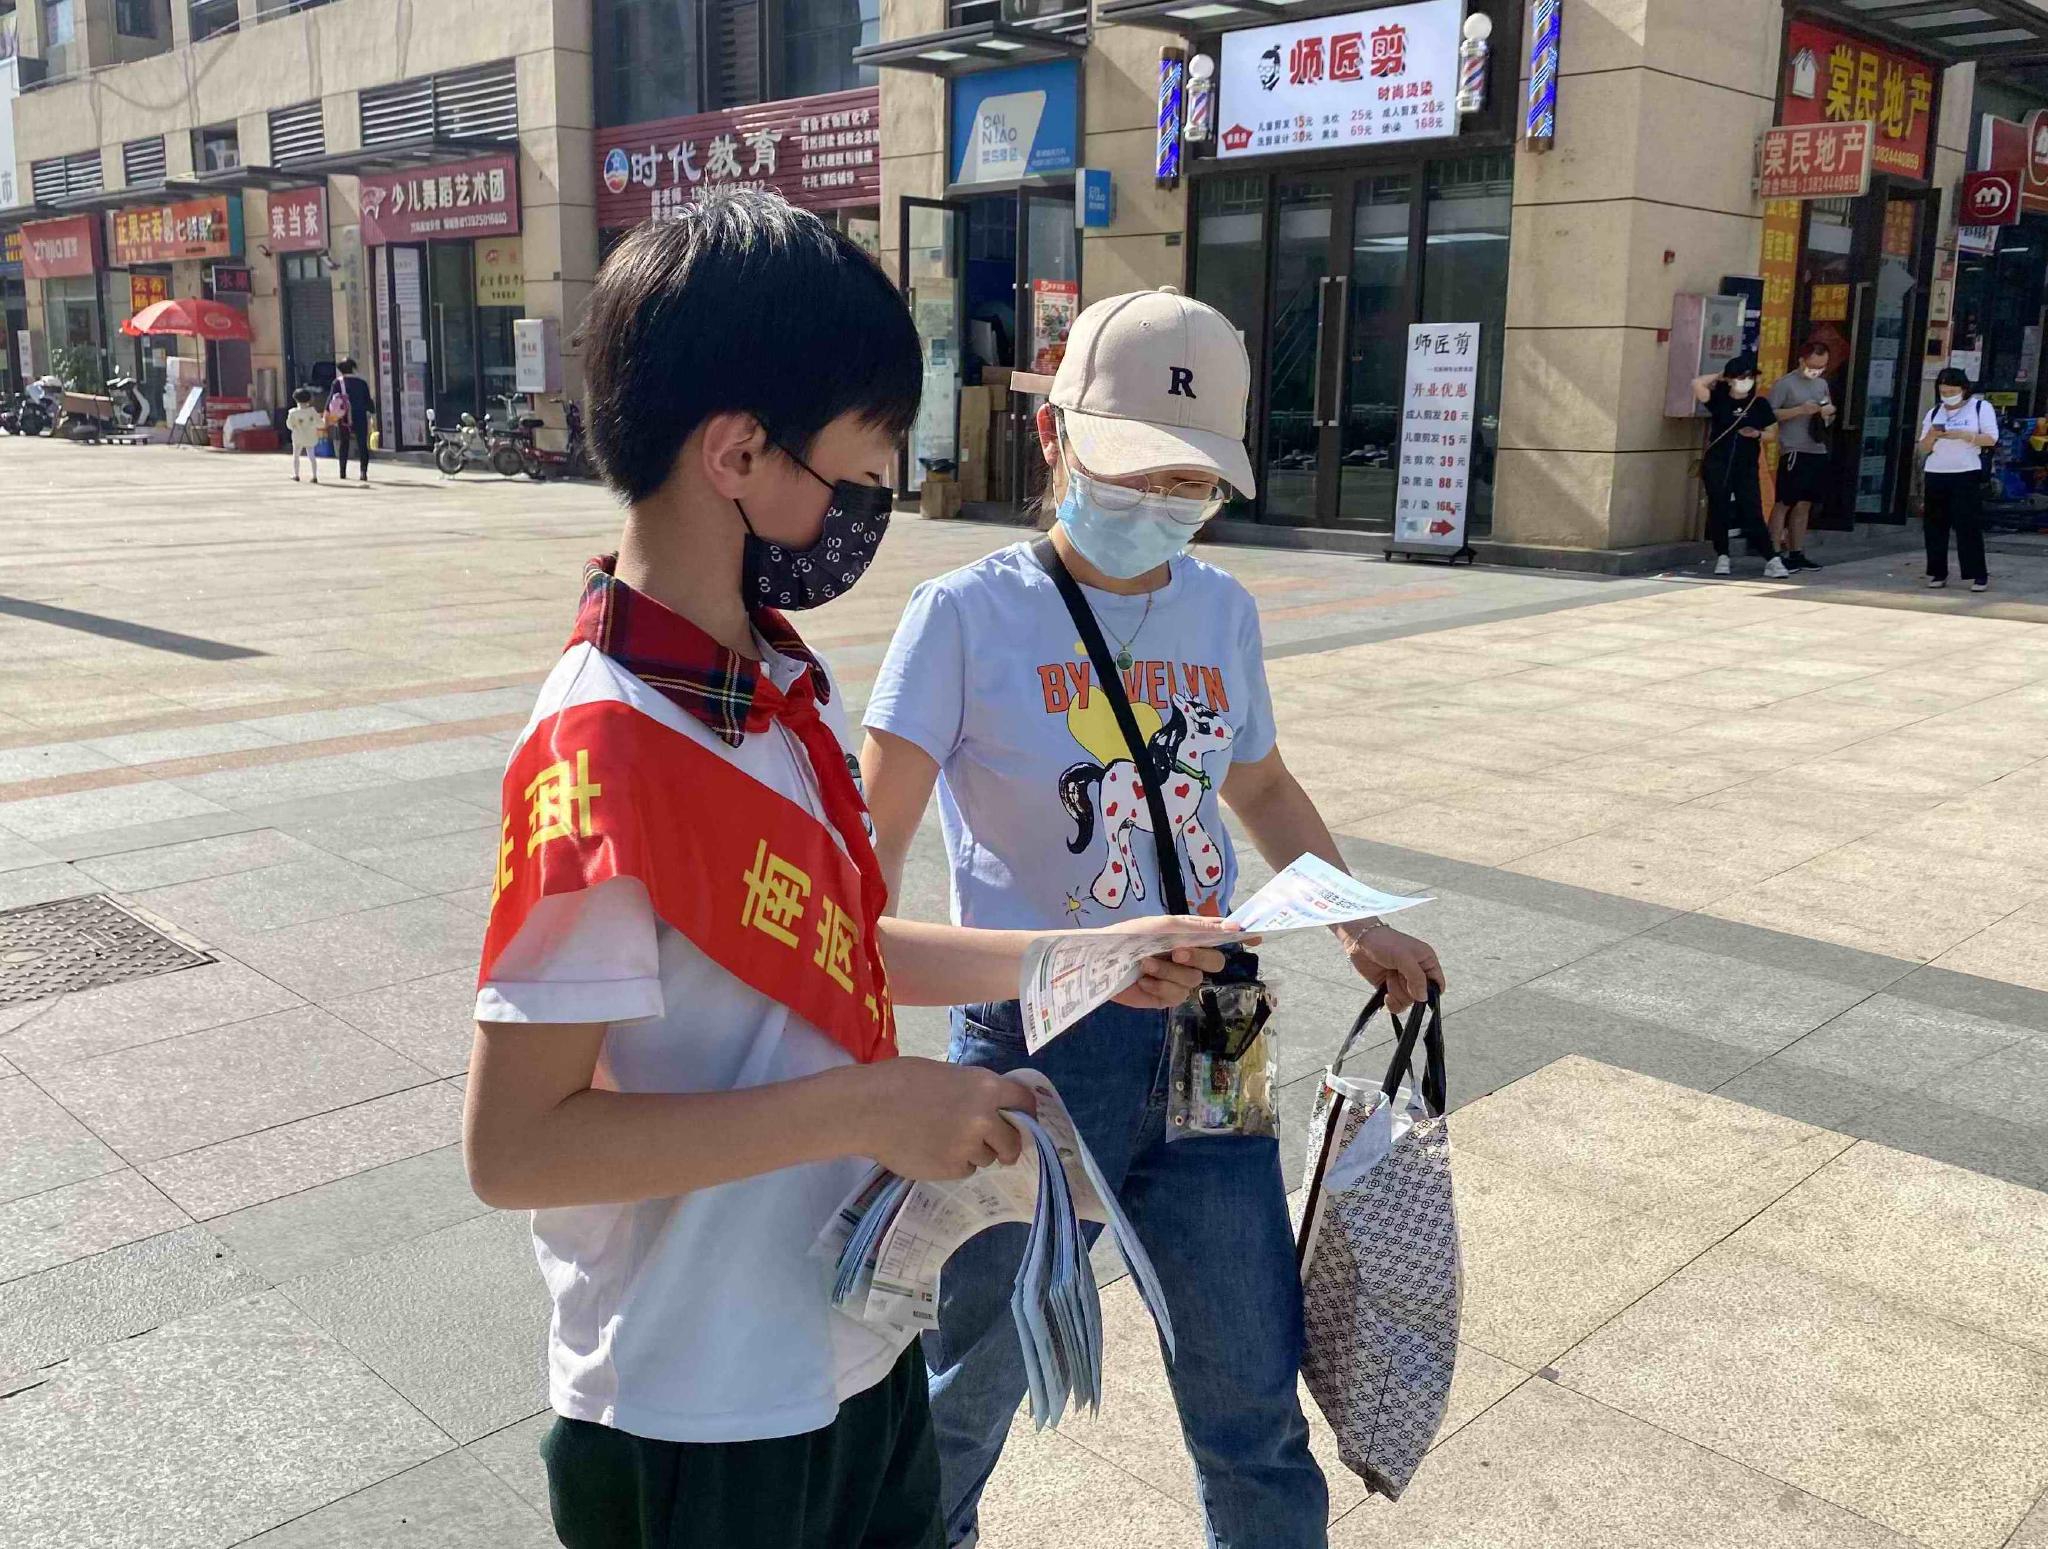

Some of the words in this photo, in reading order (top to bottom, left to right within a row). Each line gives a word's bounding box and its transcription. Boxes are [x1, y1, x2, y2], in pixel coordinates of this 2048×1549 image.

[1289, 23, 1407, 85] 师匠剪
[1377, 80, 1433, 101] 时尚烫染
[1825, 44, 1932, 140] 棠民地产
[1350, 108, 1373, 121] 25元
[1350, 124, 1373, 136] 69元
[1414, 117, 1444, 130] 168元
[630, 127, 783, 188] 时代教育
[1764, 127, 1864, 176] 棠民地产
[391, 168, 505, 215] 少儿舞蹈艺术团
[271, 201, 319, 240] 菜当家
[1413, 330, 1472, 356] 师匠剪
[1167, 366, 1197, 399] R
[1412, 382, 1468, 398] 开业优惠
[1037, 661, 1091, 713] BY
